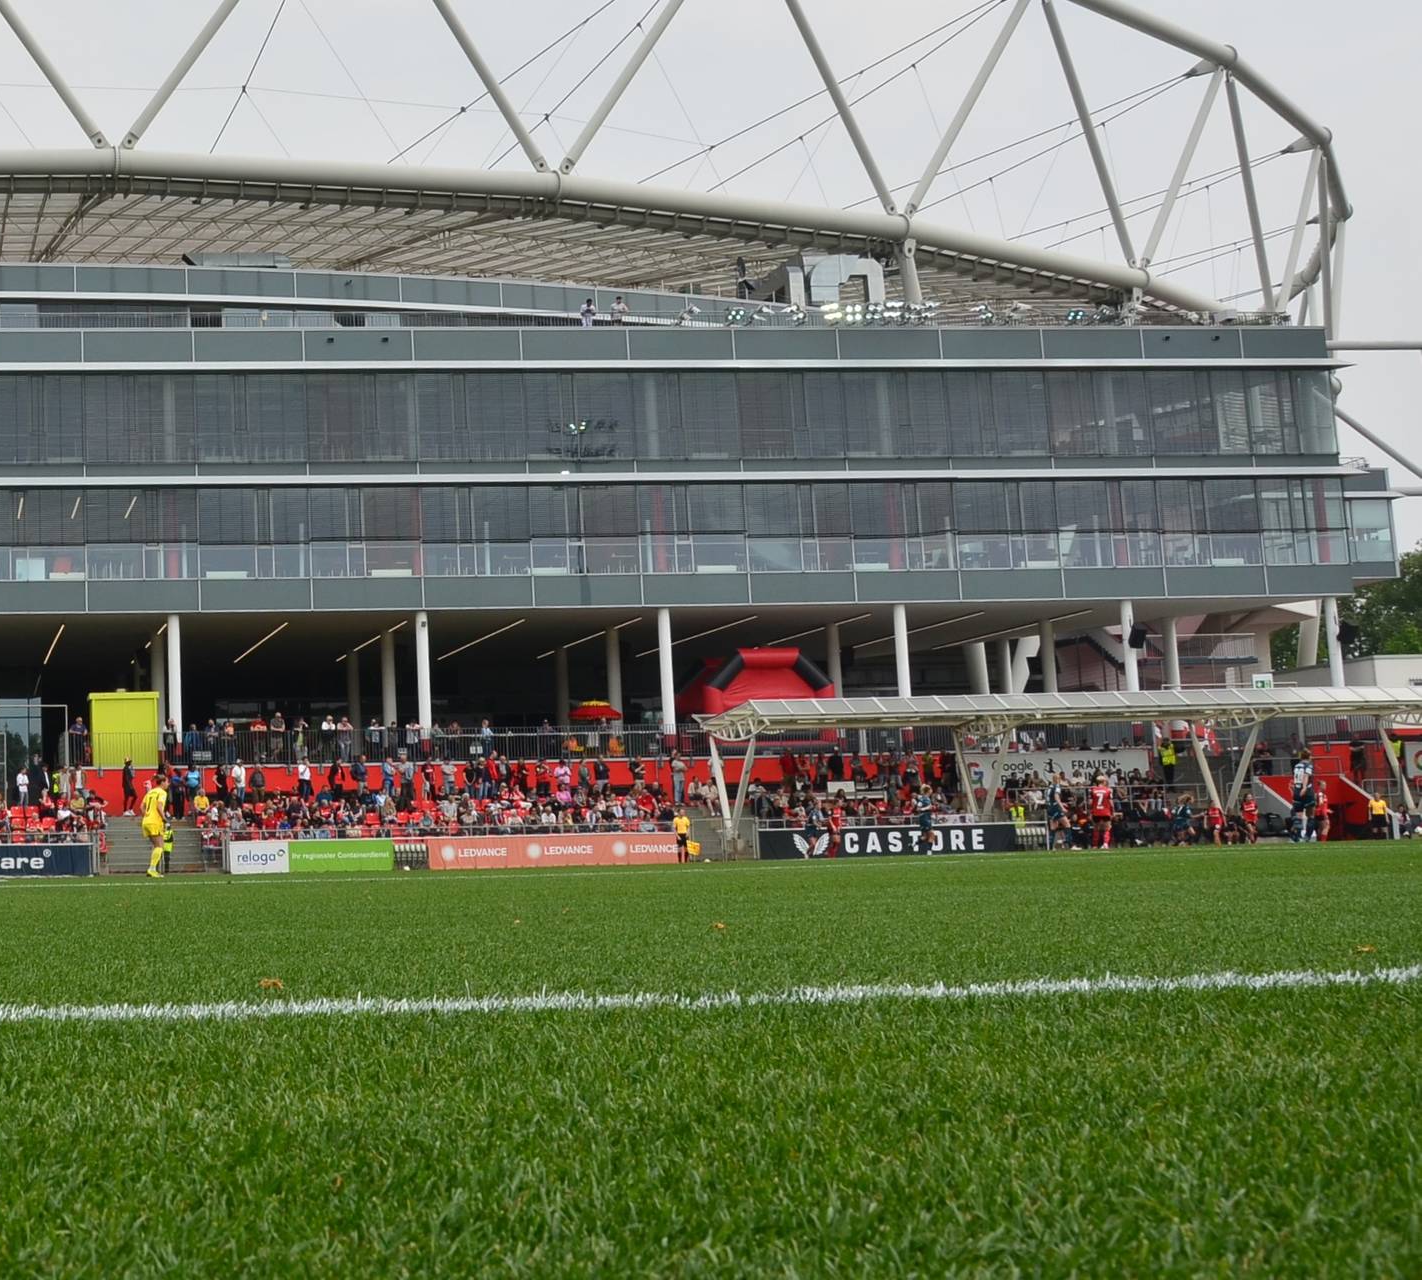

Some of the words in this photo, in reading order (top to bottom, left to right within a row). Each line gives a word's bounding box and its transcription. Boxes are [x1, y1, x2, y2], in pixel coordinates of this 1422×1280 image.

[1071, 759, 1121, 770] FRAUEN-
[844, 829, 985, 854] CASTORE
[458, 847, 508, 857] LEDVANCE
[544, 845, 594, 856] LEDVANCE
[630, 844, 679, 854] LEDVANCE
[237, 850, 276, 865] reloga
